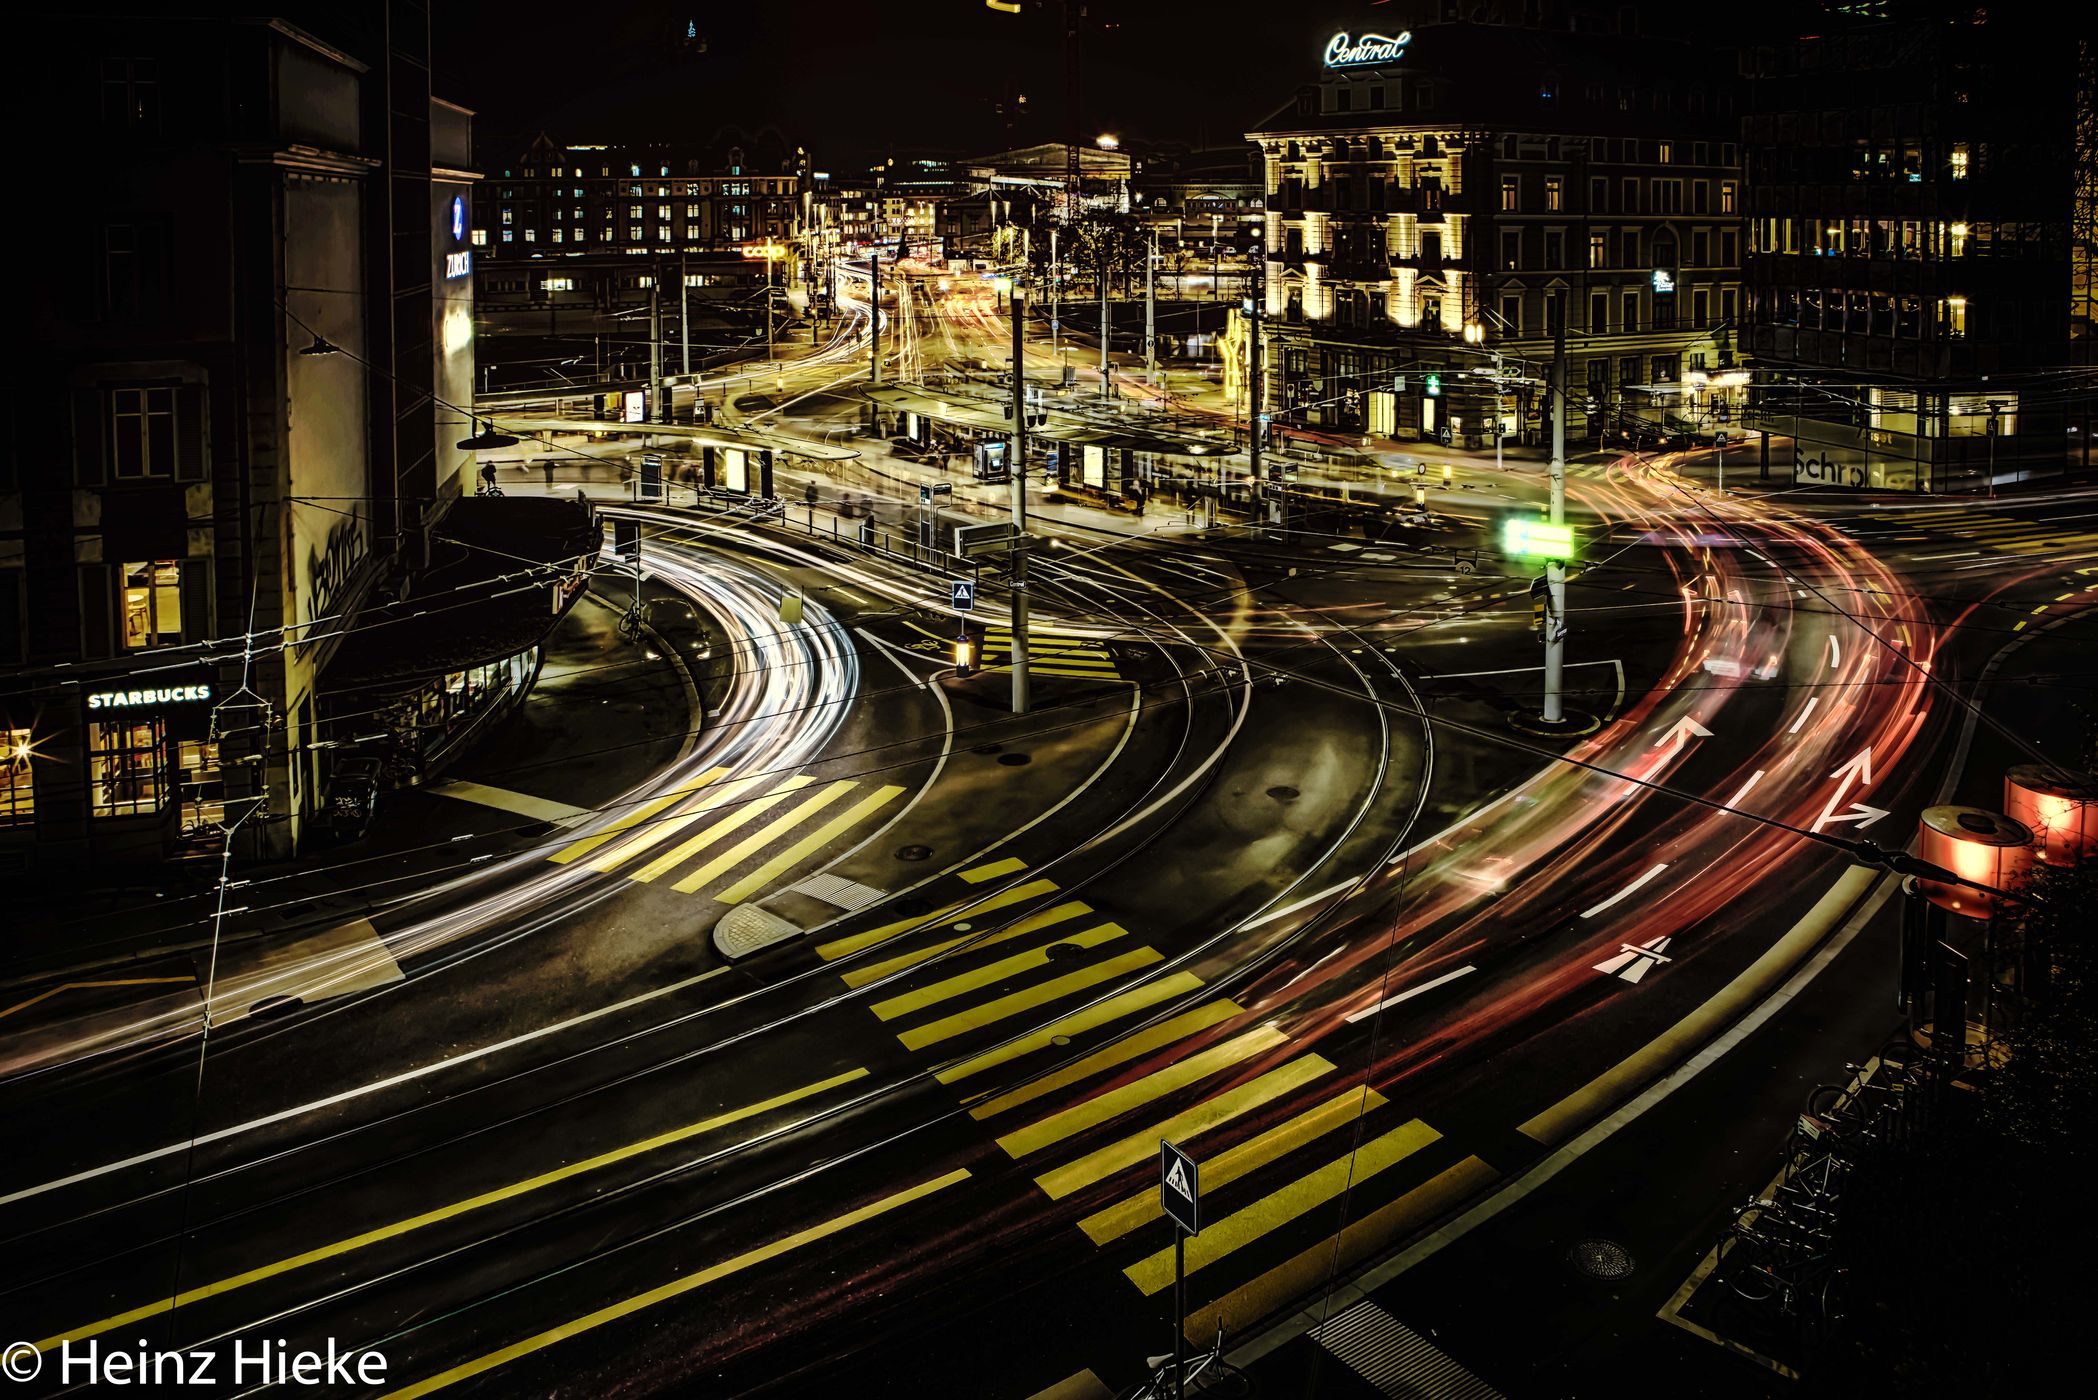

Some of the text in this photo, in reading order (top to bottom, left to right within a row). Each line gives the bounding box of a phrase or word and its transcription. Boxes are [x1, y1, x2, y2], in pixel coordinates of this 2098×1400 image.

[1325, 32, 1411, 65] Central
[446, 251, 470, 278] ZURICH
[743, 245, 785, 261] coop
[88, 685, 210, 708] STARBUCKS
